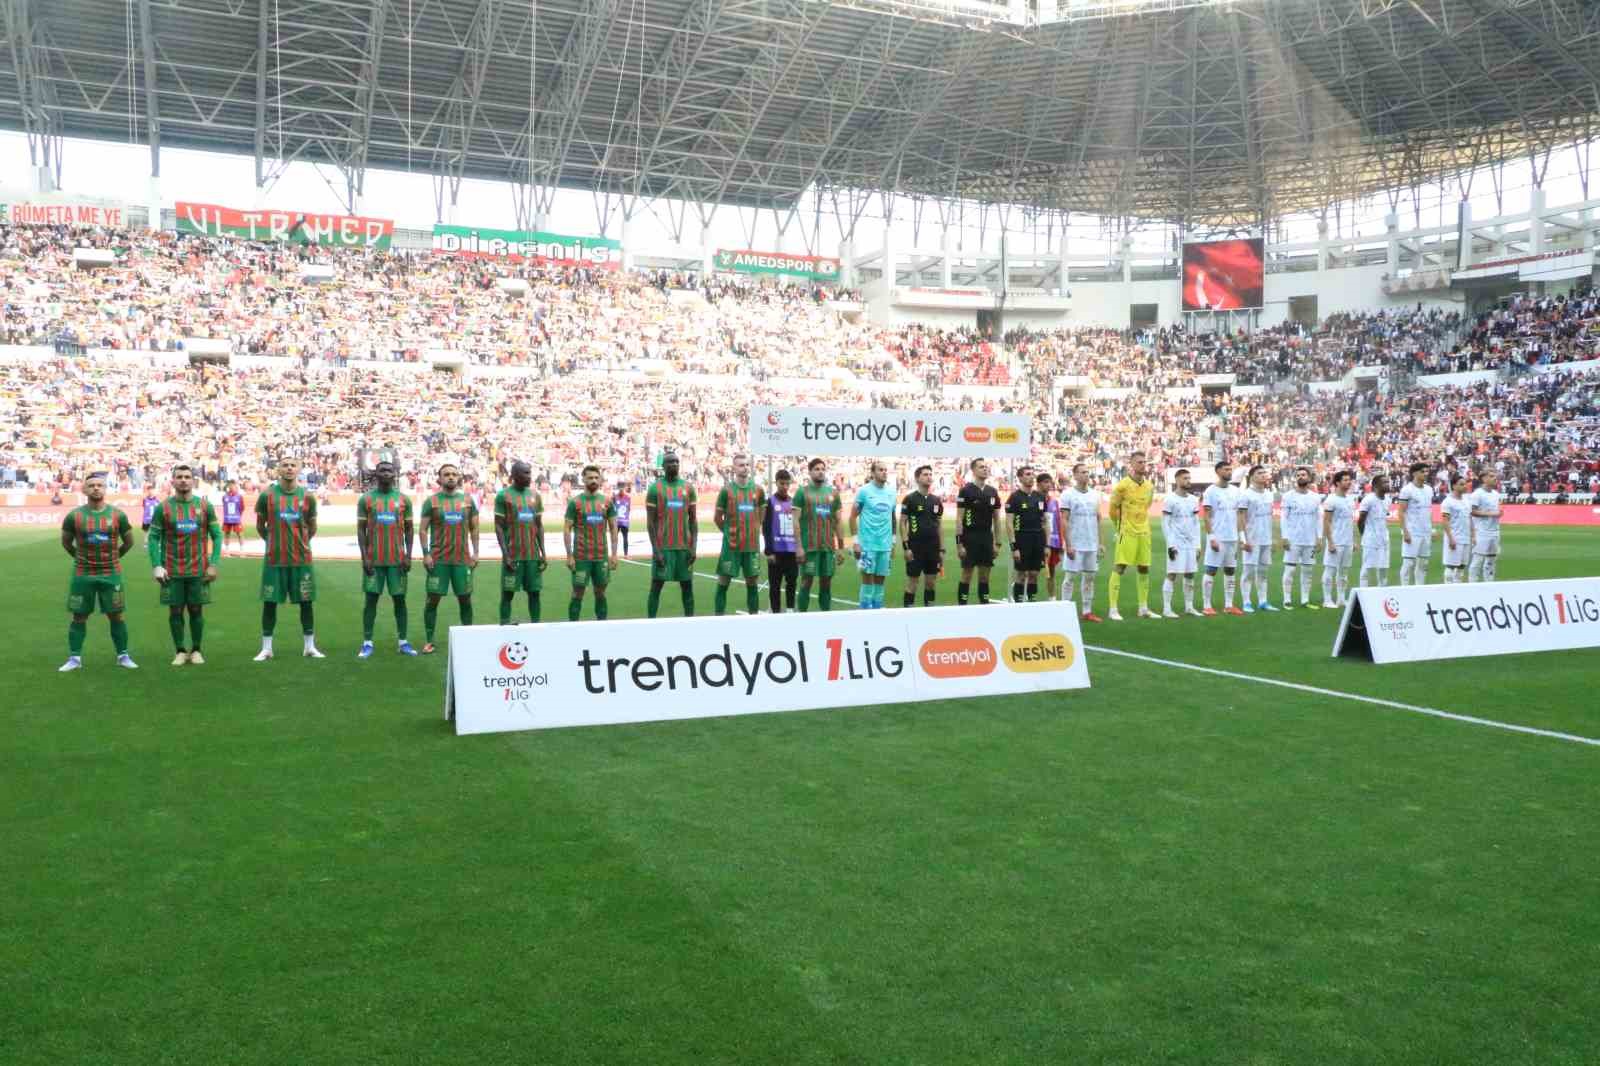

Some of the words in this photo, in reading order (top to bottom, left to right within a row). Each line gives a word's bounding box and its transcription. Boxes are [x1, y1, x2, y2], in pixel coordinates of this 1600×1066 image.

[78, 205, 99, 225] ME
[734, 253, 814, 273] AMEDSPOR
[802, 417, 906, 446] trendyol
[1426, 595, 1550, 634] trendyol
[927, 648, 991, 667] trendyol
[577, 640, 808, 696] trendyol
[483, 672, 549, 689] trendyol
